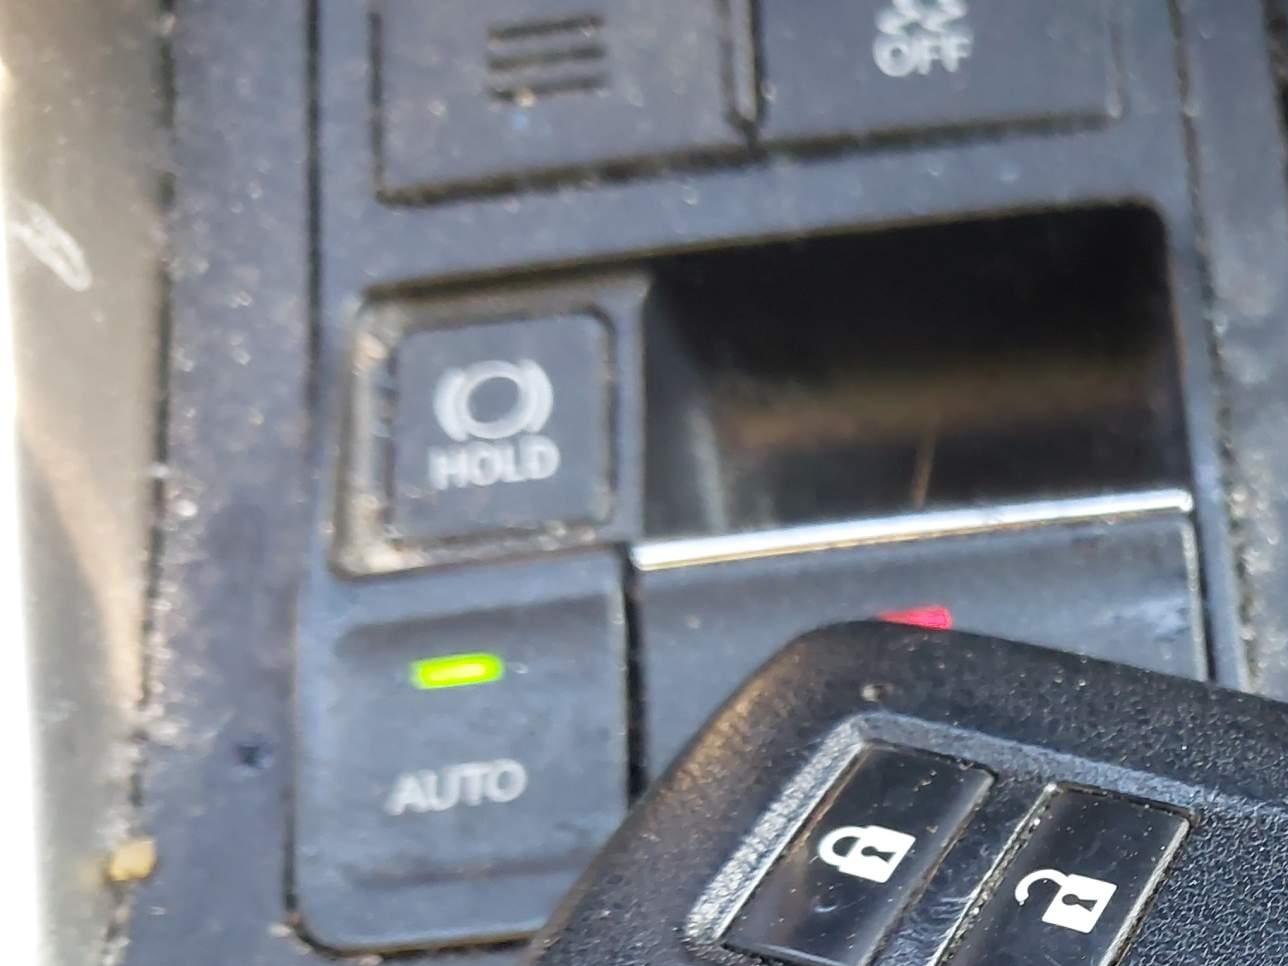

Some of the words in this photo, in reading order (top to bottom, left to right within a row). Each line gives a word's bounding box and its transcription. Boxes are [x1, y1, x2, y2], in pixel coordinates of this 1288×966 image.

[872, 34, 973, 77] OFF
[428, 434, 562, 491] HOLD
[385, 758, 527, 815] AUTO
